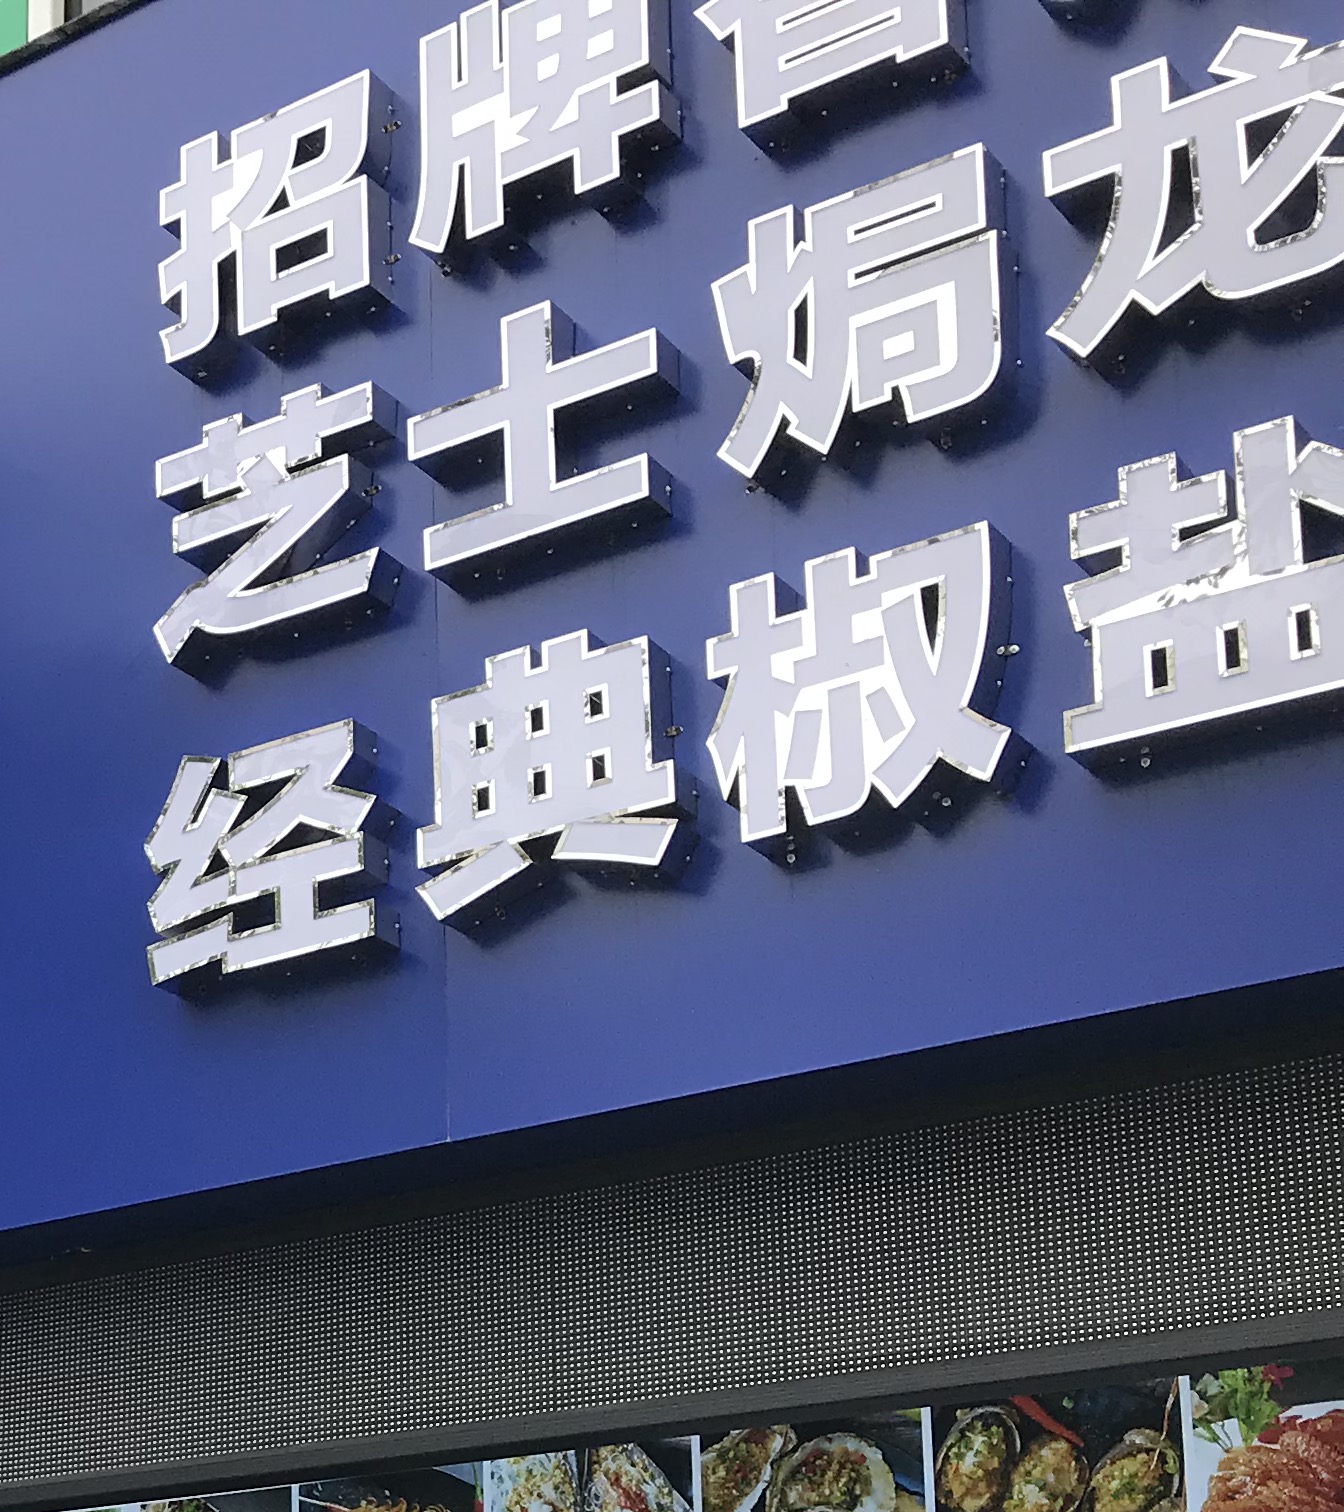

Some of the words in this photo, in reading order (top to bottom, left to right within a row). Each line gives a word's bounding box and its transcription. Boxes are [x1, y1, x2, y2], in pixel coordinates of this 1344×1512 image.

[153, 28, 1344, 664] 芝士焗龙
[146, 414, 1344, 986] 经典椒盐
